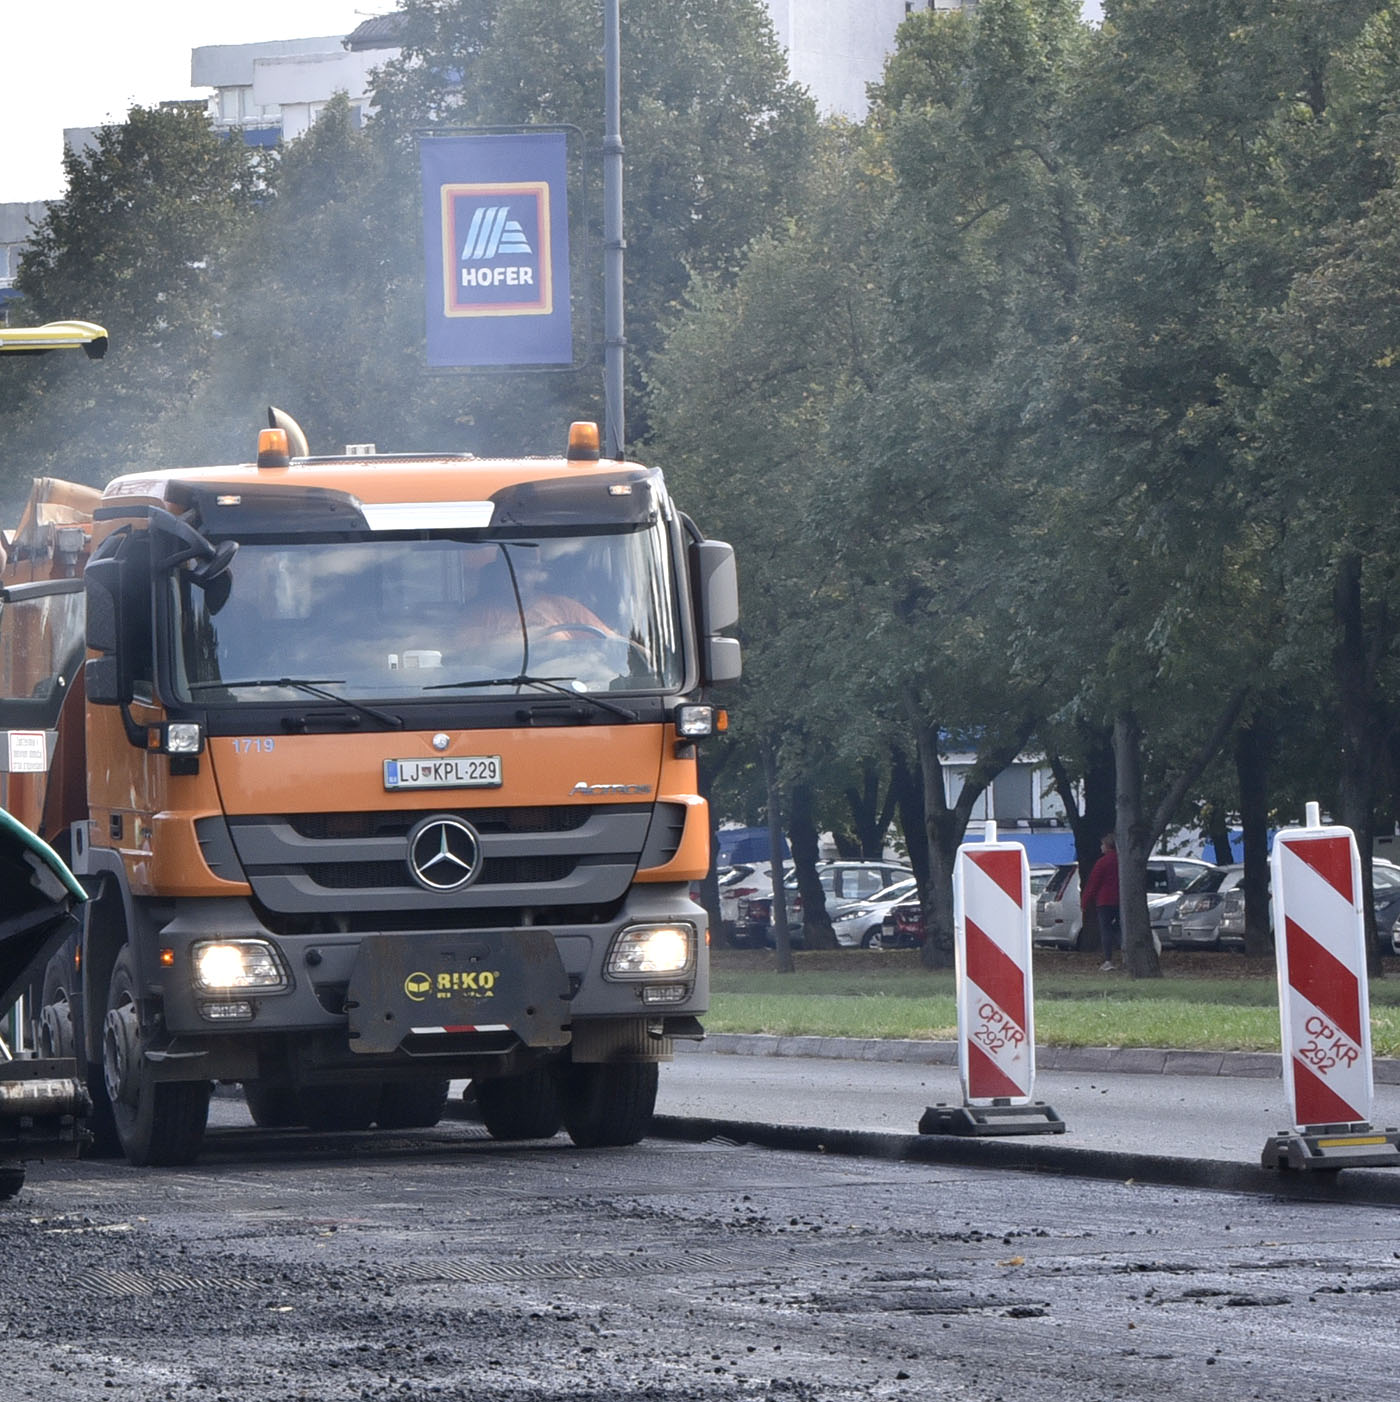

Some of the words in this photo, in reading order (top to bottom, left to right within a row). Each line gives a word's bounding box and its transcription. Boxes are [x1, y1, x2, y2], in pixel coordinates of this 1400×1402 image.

[461, 266, 534, 287] HOFER
[232, 738, 274, 753] 1719
[400, 764, 419, 782] LJ
[437, 971, 495, 989] RIKO
[974, 1024, 1005, 1055] 292
[1299, 1040, 1336, 1075] 292
